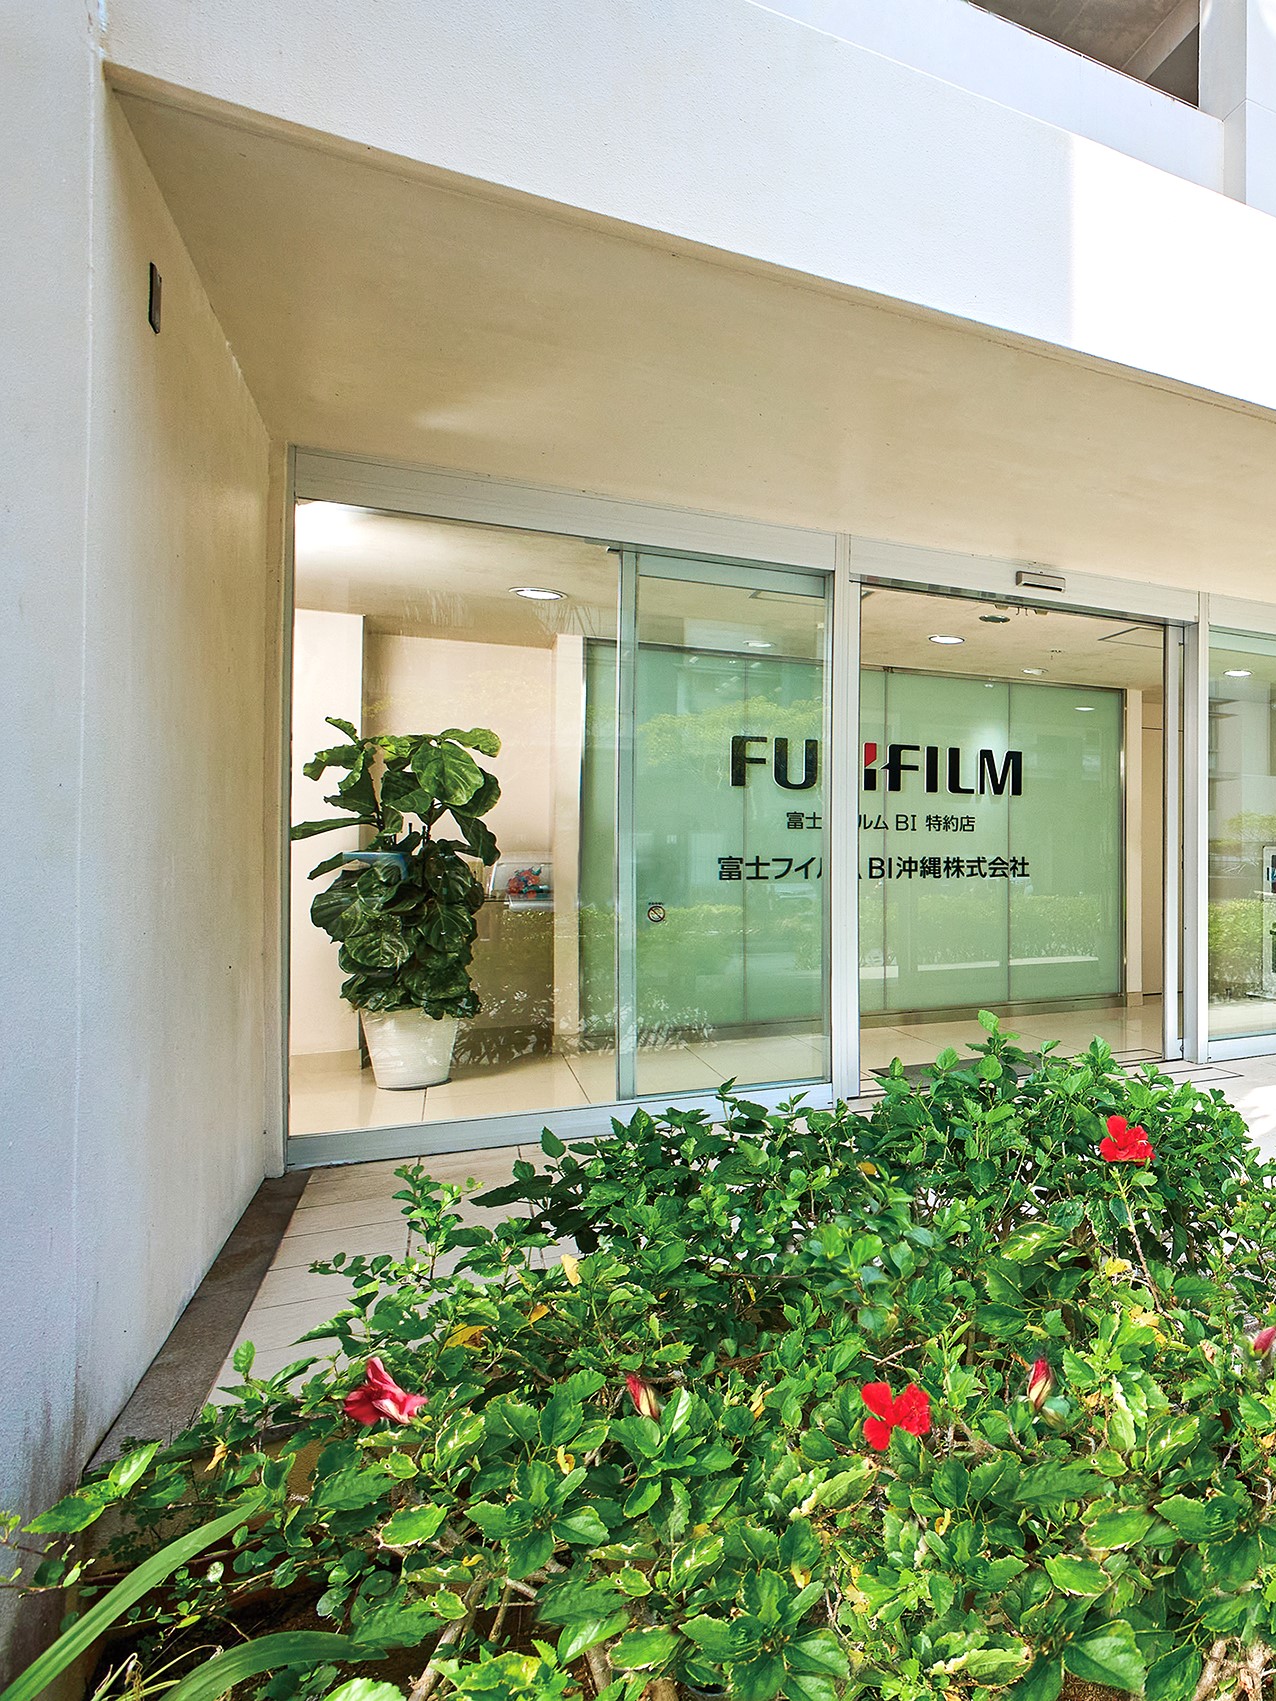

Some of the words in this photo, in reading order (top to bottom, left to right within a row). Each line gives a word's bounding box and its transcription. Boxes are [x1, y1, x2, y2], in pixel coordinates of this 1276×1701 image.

[730, 735, 1023, 796] FUIFILM
[786, 811, 889, 831] 富士ルム
[895, 814, 917, 832] BI
[925, 814, 976, 833] 特約店
